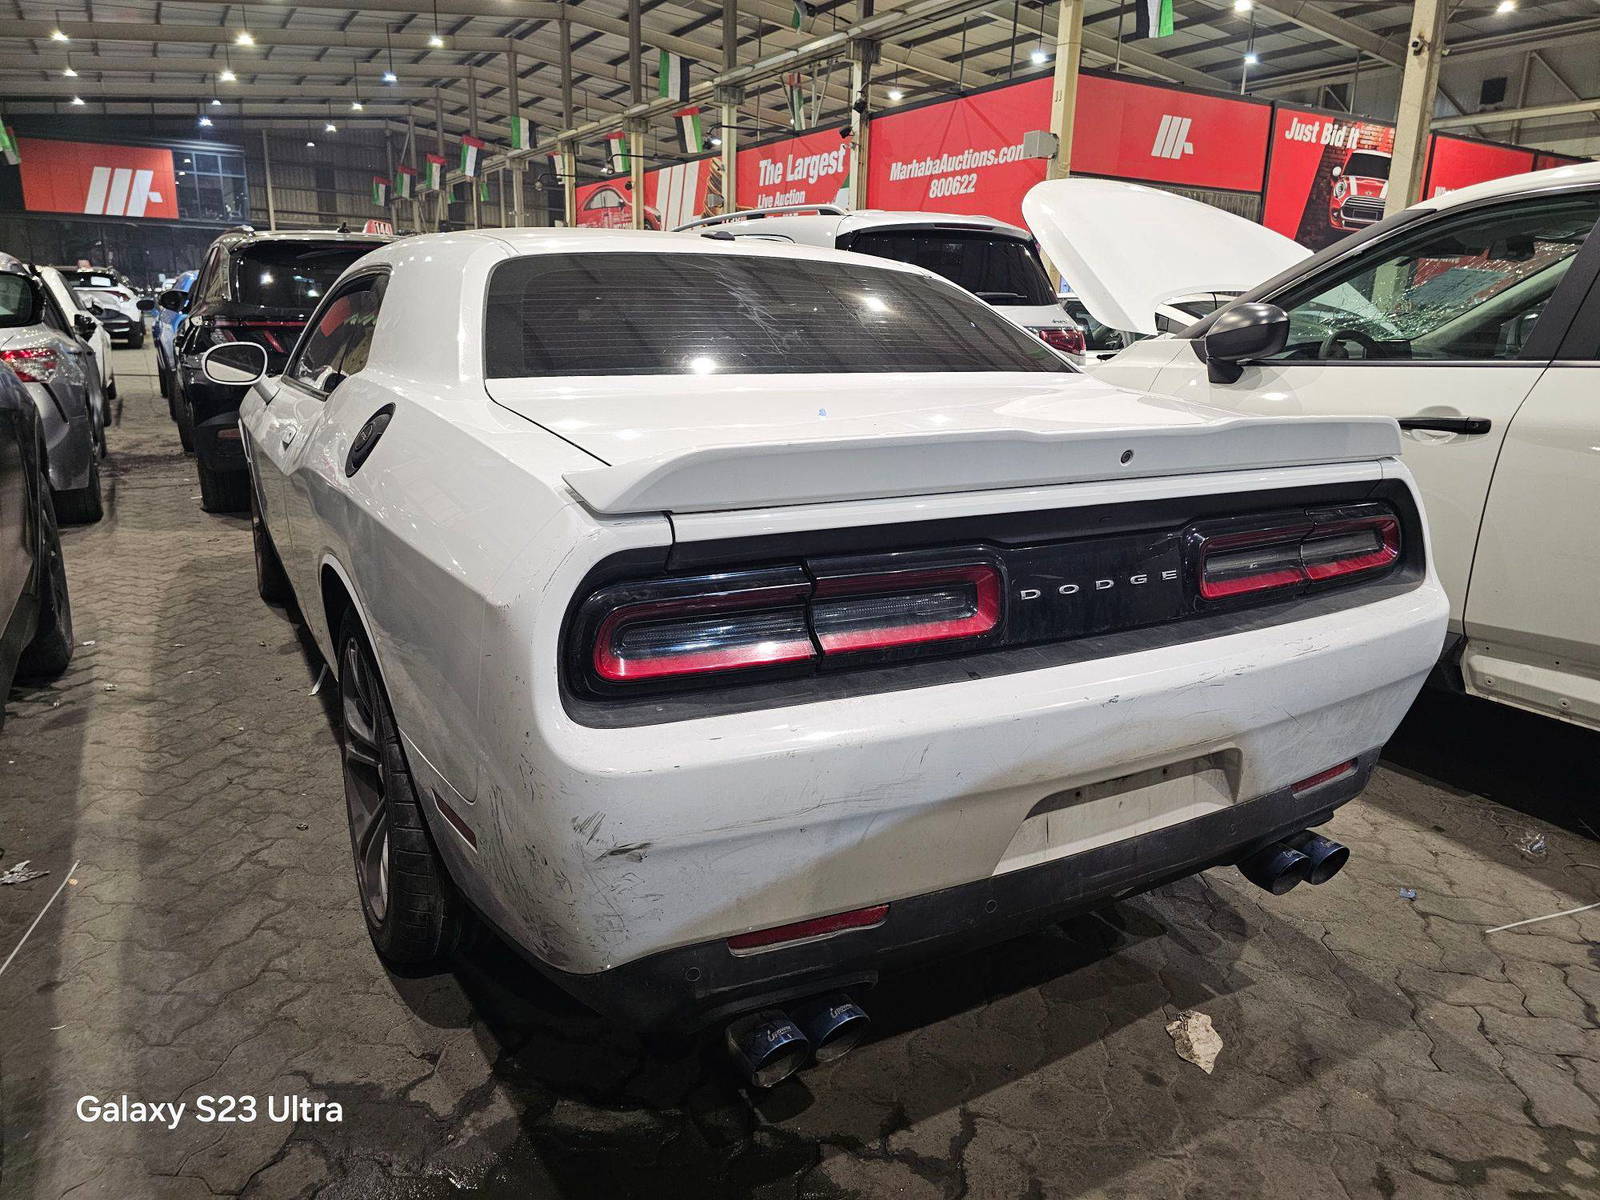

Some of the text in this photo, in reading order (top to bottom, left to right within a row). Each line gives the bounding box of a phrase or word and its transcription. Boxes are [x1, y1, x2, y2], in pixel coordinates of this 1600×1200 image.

[1285, 117, 1360, 150] Just Bid It
[759, 146, 846, 187] The Largest
[757, 188, 806, 209] Live Auction
[929, 173, 978, 198] 800622
[1020, 569, 1178, 600] DODGE
